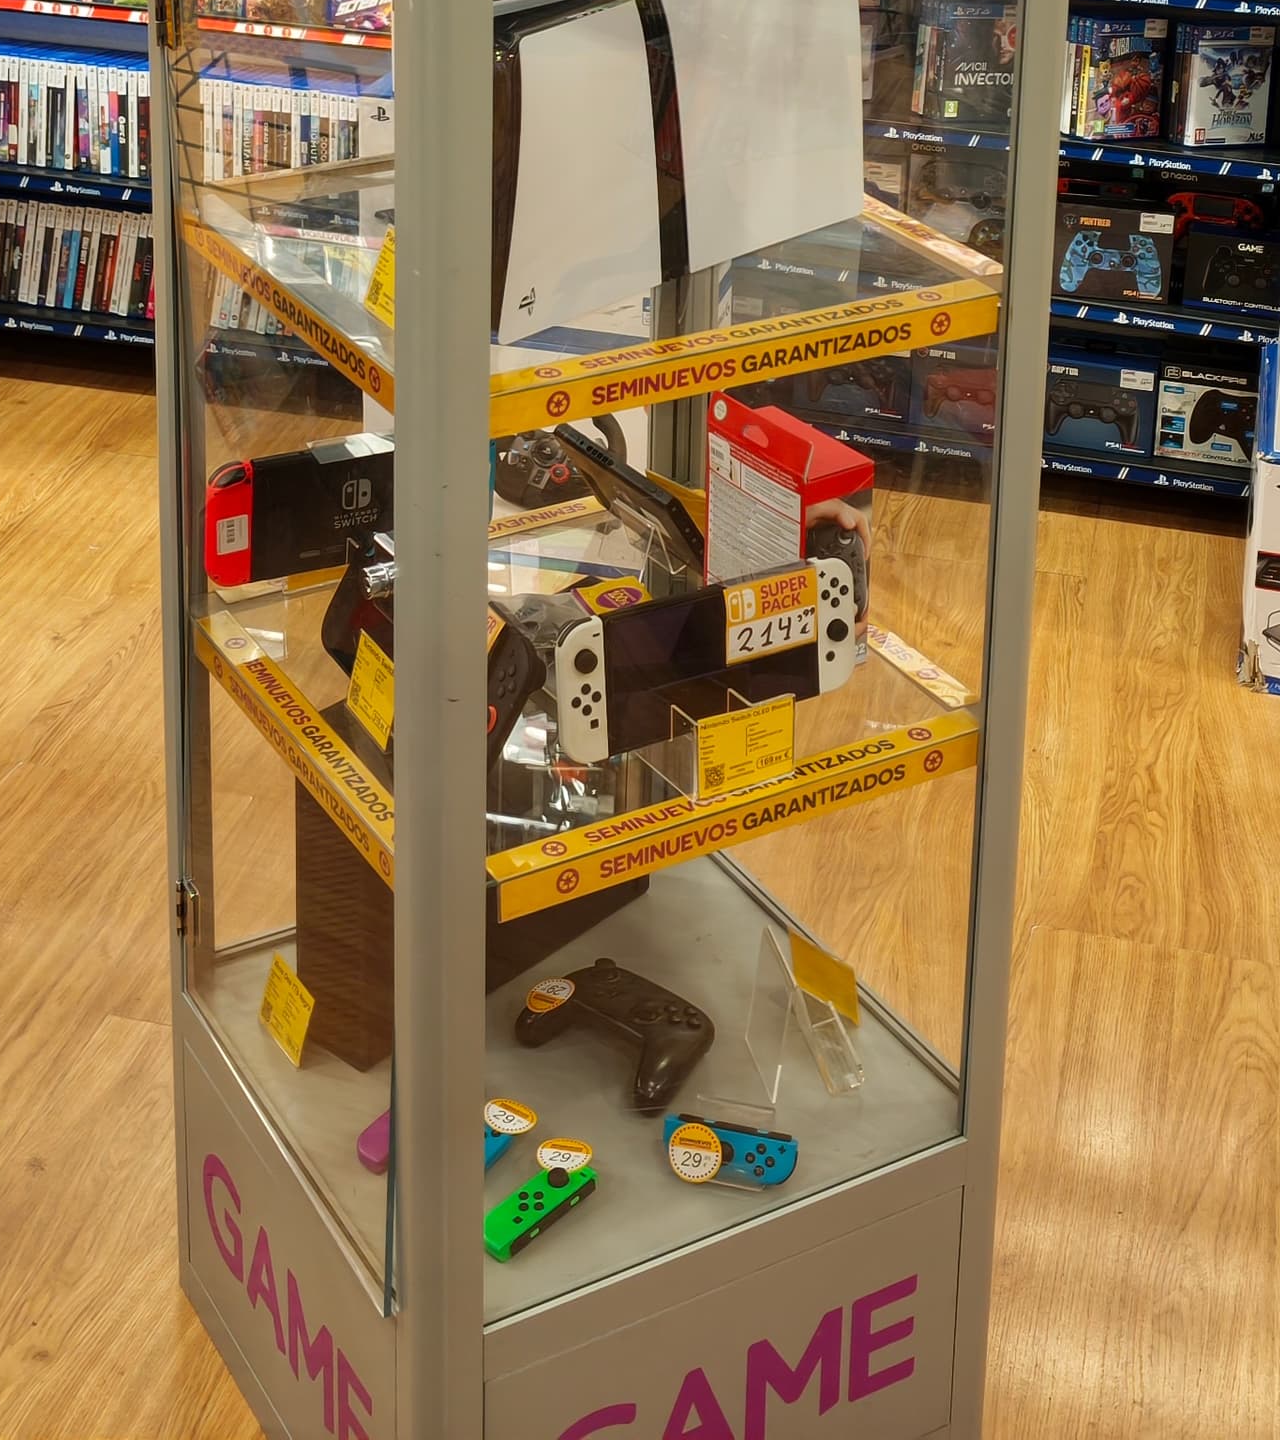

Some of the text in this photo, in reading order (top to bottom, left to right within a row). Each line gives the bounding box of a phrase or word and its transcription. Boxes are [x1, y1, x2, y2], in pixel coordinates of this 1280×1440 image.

[591, 322, 911, 405] SEMINUEVOS GARANTIZADOS
[760, 576, 808, 599] SUPER
[761, 592, 801, 614] PACK
[600, 763, 907, 878] SEMINUEVOS GARANTIZADOS
